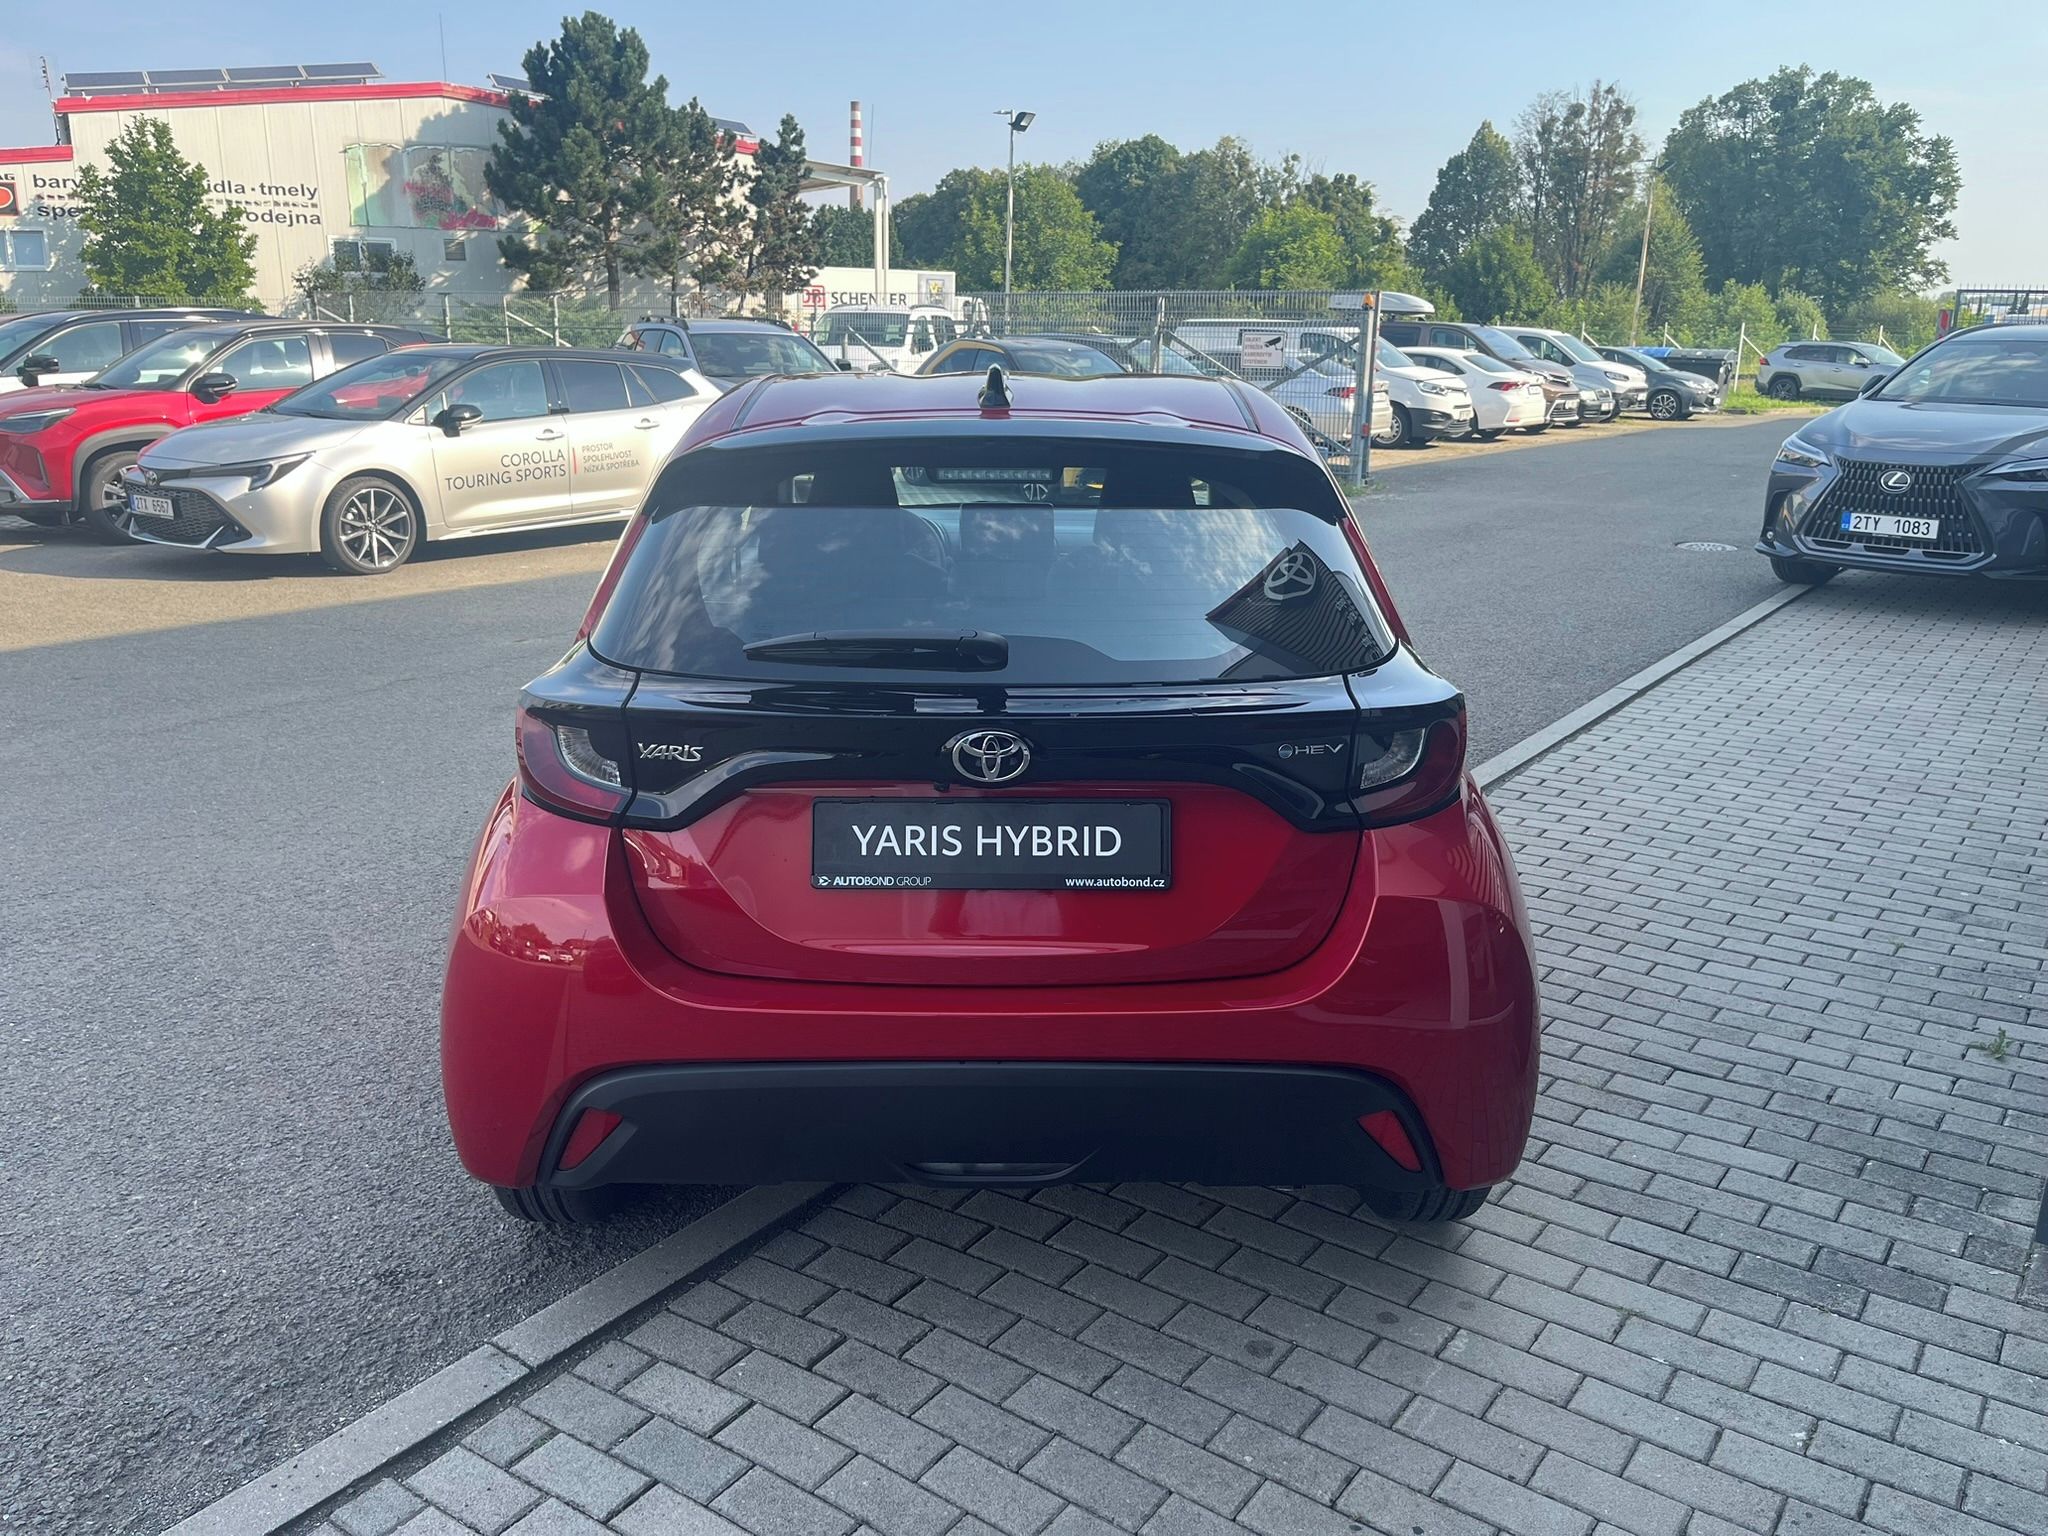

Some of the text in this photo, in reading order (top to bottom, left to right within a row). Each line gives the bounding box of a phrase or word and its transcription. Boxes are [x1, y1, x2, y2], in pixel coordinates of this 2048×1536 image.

[32, 174, 81, 188] barv
[259, 182, 317, 200] tmely
[245, 209, 321, 227] odejna
[831, 291, 907, 305] SCHENER
[582, 442, 613, 452] PROSTOR
[500, 449, 566, 467] COROLLA
[445, 464, 566, 490] TOURING SPORTS
[1853, 515, 1881, 531] 2TY
[1894, 519, 1931, 536] 1083
[637, 742, 704, 762] YARIS
[1294, 743, 1344, 755] HEV
[852, 825, 1122, 857] YARIS HYBRID
[833, 876, 1165, 888] AUTOBOND GROUP www.autobond.cz
